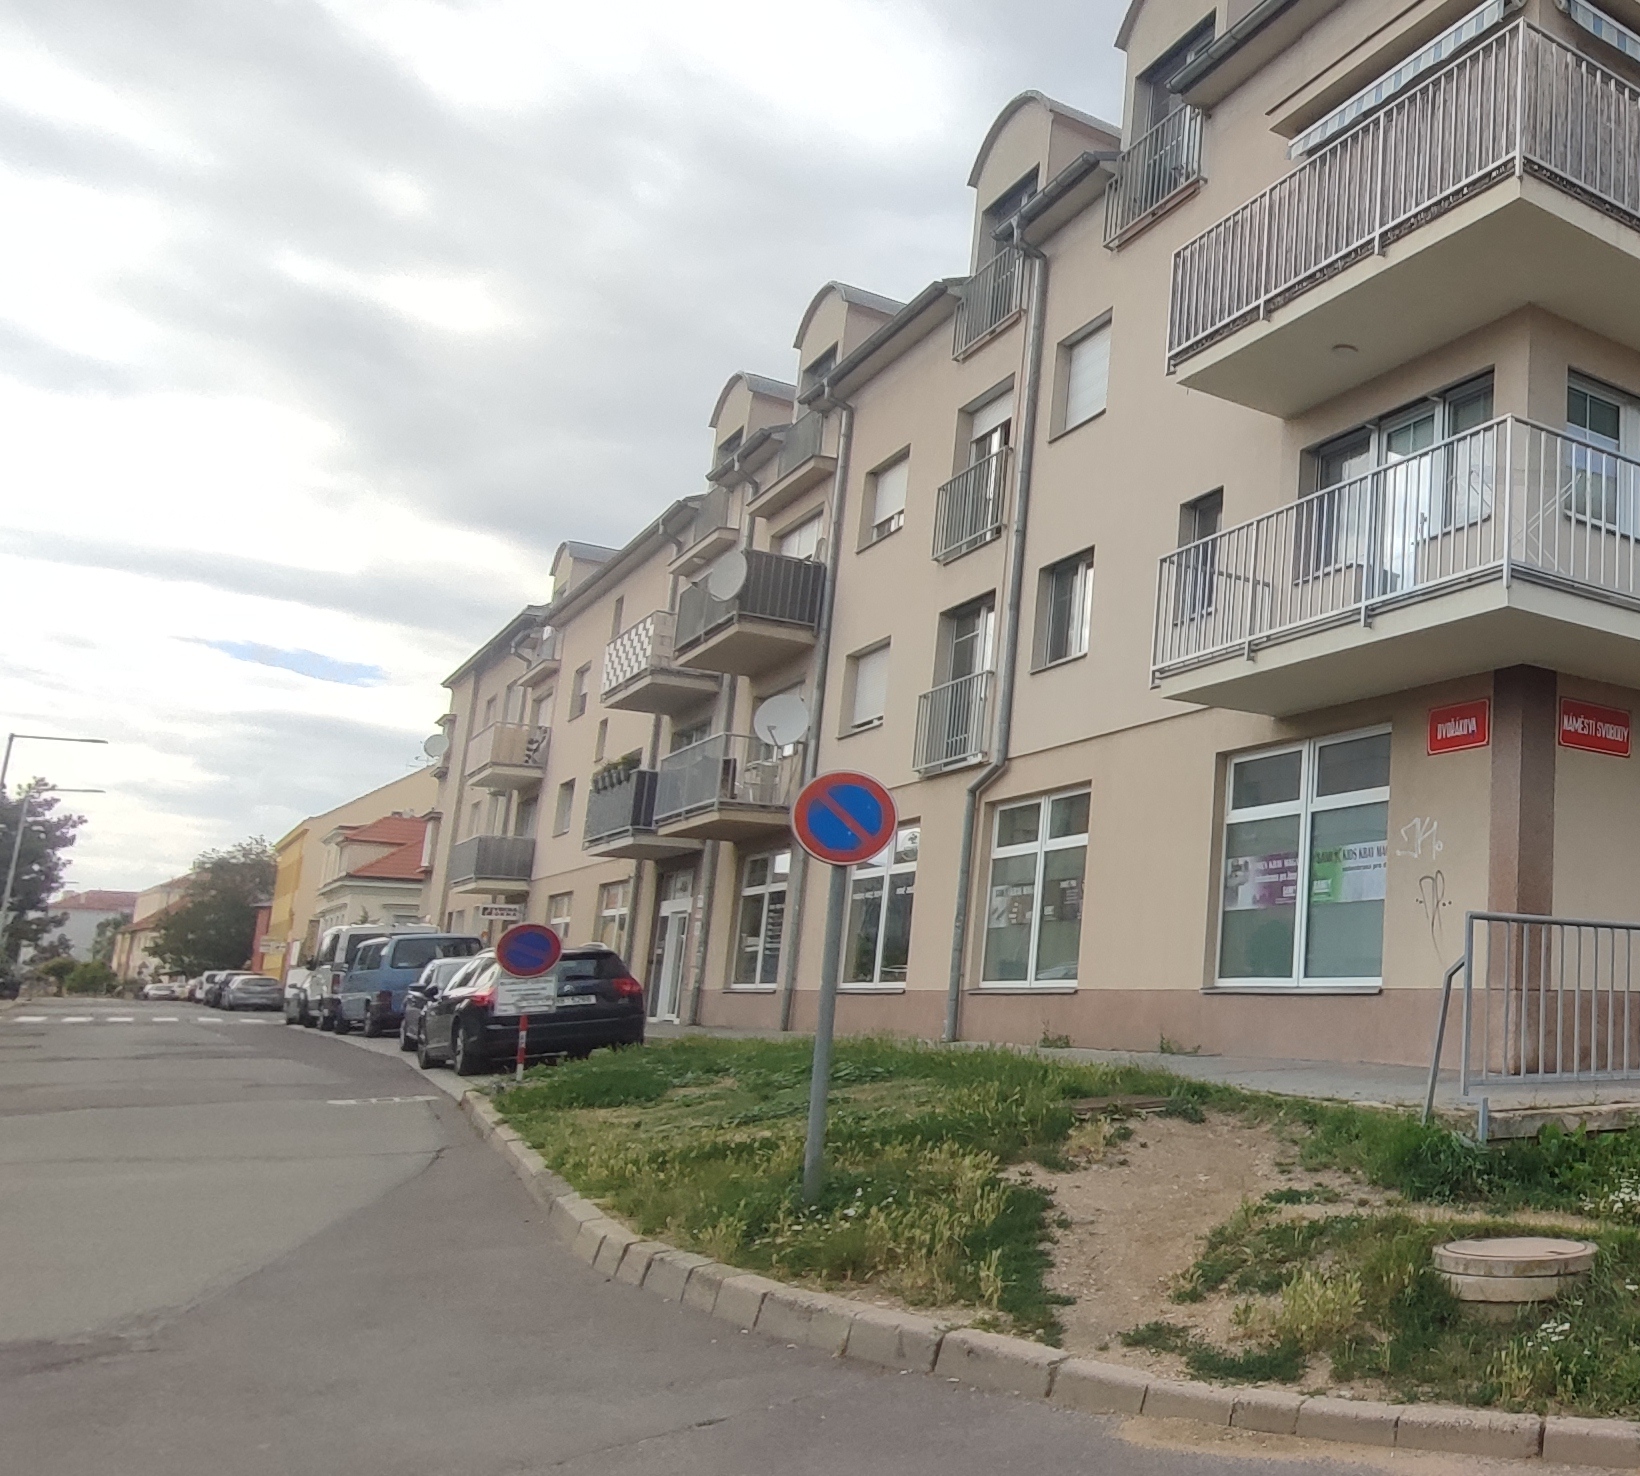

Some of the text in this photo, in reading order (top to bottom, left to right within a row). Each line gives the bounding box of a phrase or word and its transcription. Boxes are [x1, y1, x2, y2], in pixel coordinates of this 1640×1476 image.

[1436, 716, 1477, 740] DVOŘÁKOVA
[1563, 711, 1629, 743] NÁMĚSTÍ SVOBODY
